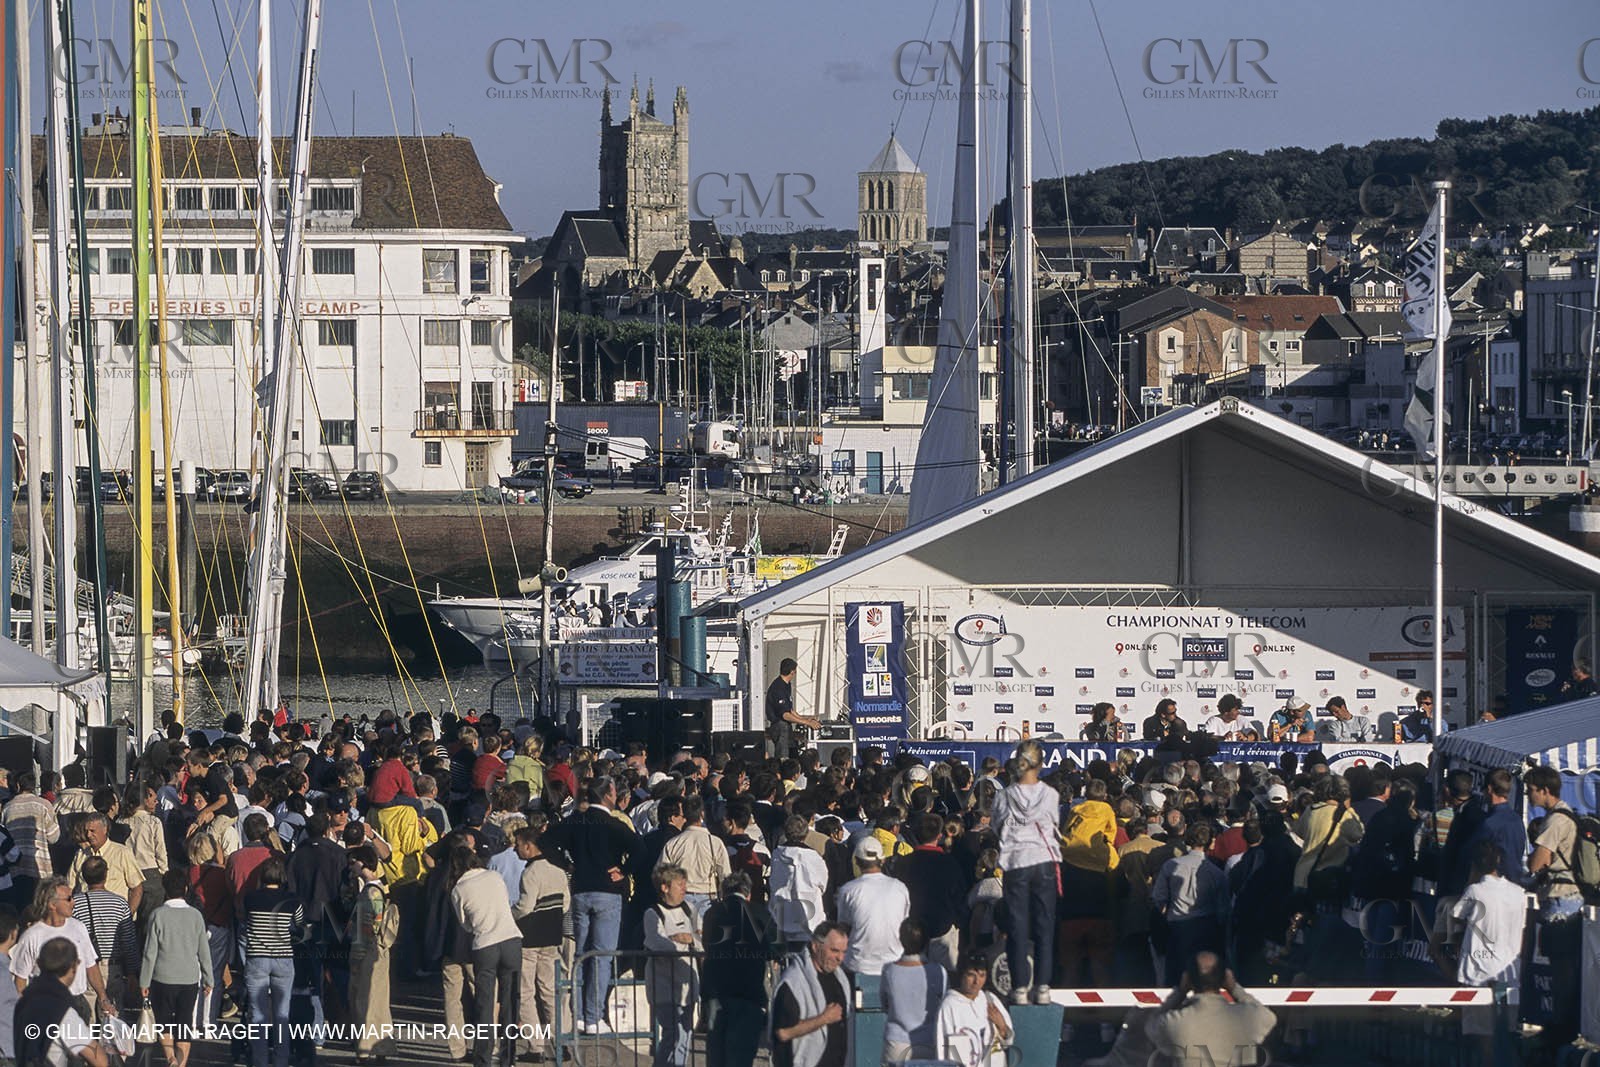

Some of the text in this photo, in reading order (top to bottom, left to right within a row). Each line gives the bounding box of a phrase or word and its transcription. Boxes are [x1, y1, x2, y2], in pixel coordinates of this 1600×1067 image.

[299, 302, 361, 314] CAMP
[975, 619, 984, 631] 9
[1106, 615, 1307, 629] CHAMPIONNAT 9 TELECOM
[1186, 643, 1225, 653] ROYALE
[856, 700, 903, 713] Normandie
[1338, 747, 1383, 760] CHAMPIONNAT
